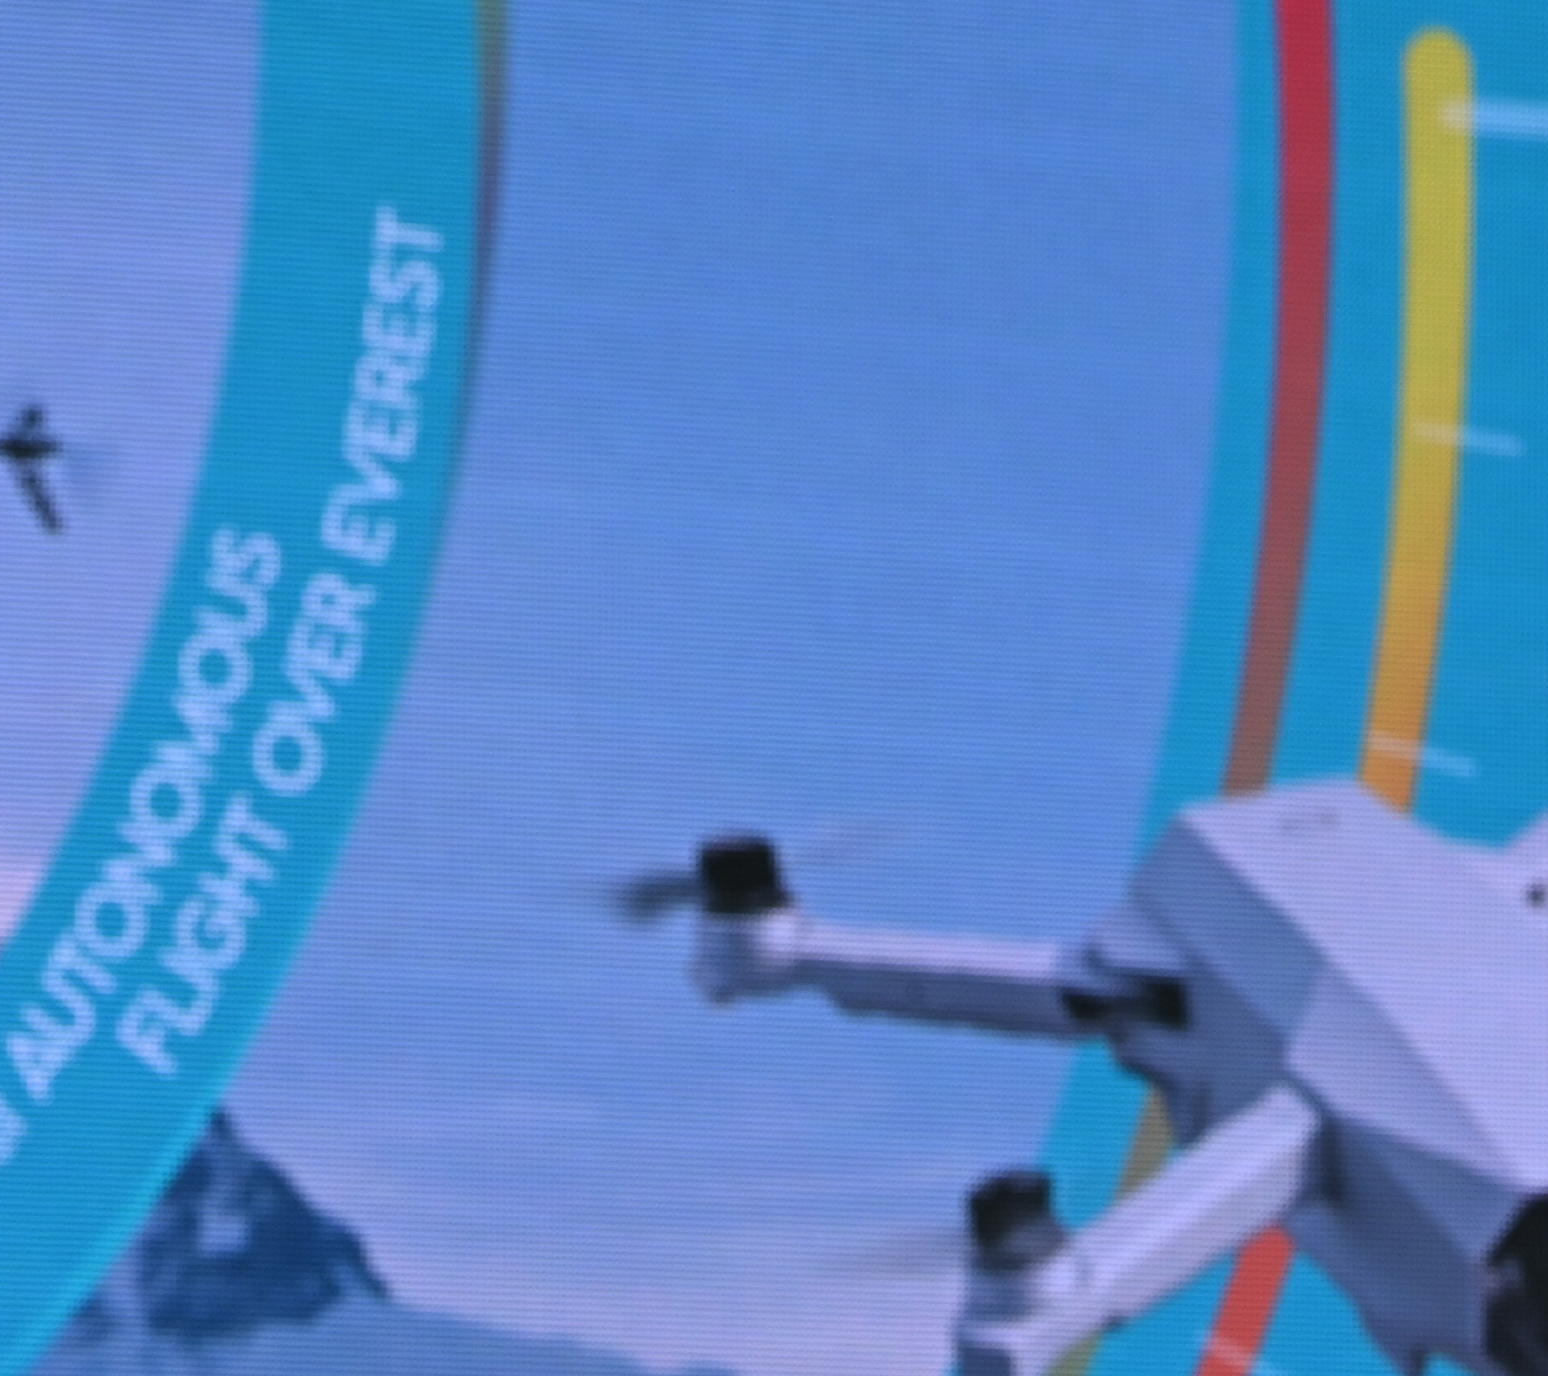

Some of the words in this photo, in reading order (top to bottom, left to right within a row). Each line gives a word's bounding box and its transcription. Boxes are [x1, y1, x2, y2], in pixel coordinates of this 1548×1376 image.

[5, 527, 282, 1105] AUTONOMOUS
[115, 789, 289, 1080] FLIGHT
[251, 572, 377, 798] OVER
[320, 206, 445, 567] EVEREST
